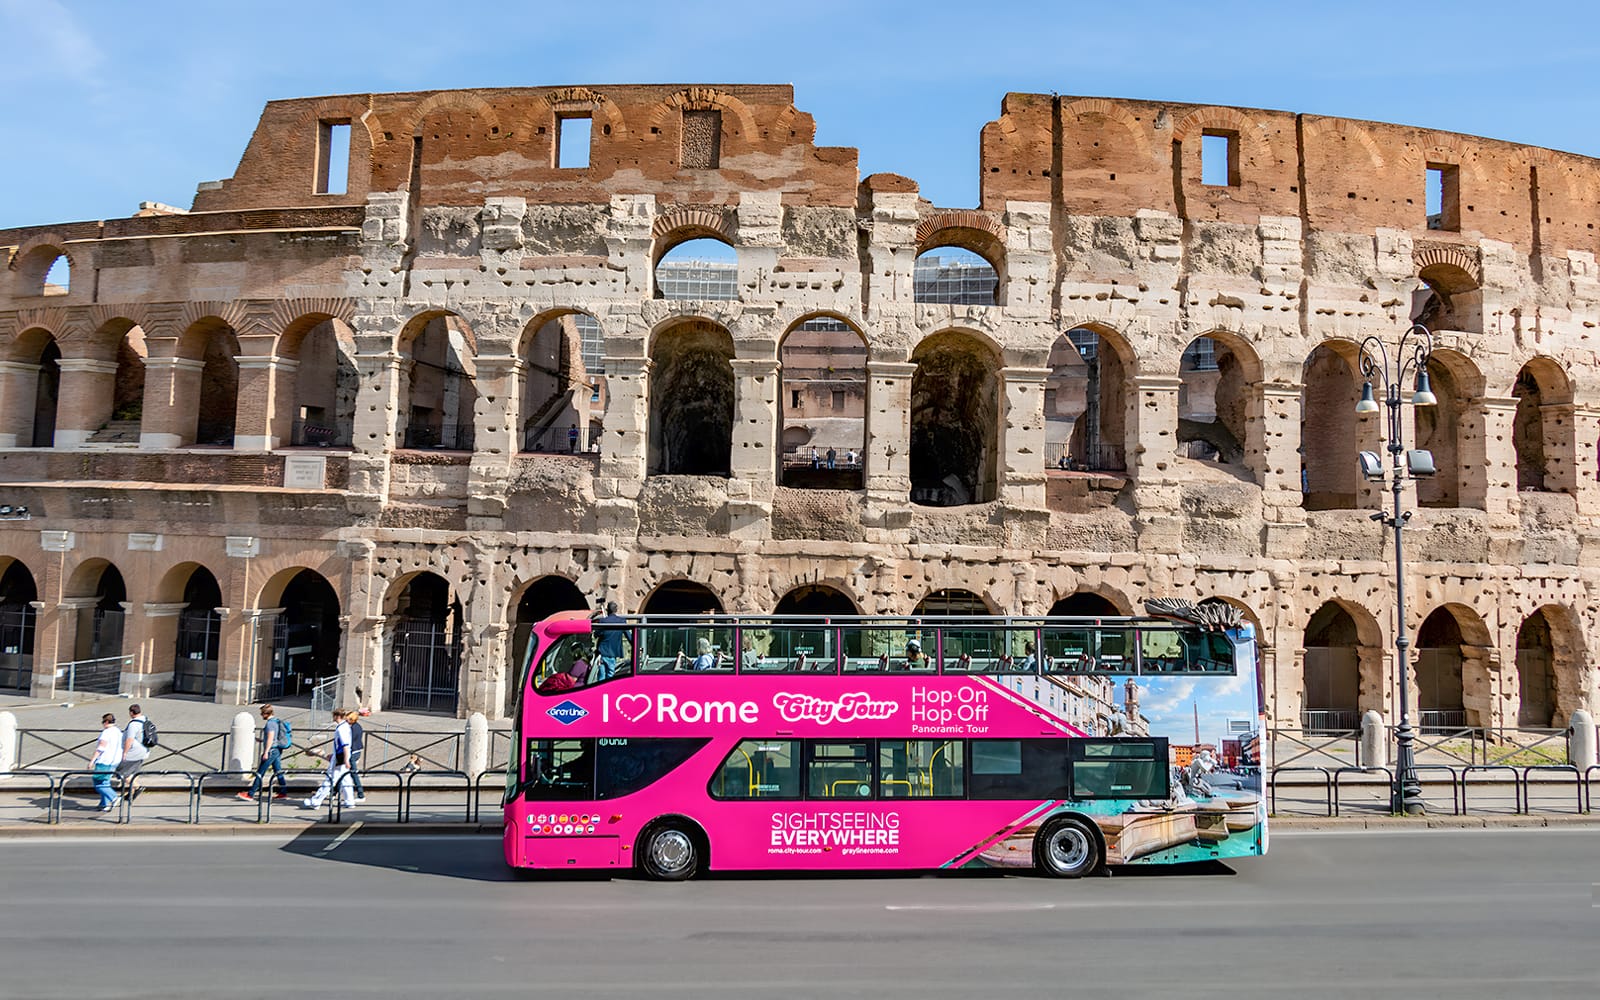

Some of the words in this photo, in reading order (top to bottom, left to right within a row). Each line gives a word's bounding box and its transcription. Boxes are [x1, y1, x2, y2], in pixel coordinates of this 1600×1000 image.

[602, 693, 609, 723] I
[657, 693, 759, 723] Rome
[772, 691, 835, 725] City
[836, 691, 899, 723] Tour
[912, 724, 964, 733] Panoramic
[966, 724, 989, 733] Tour
[771, 812, 900, 830] SIGHTSEEING
[771, 829, 900, 846] EVERYWHERE
[842, 847, 899, 856] graylinerome.com
